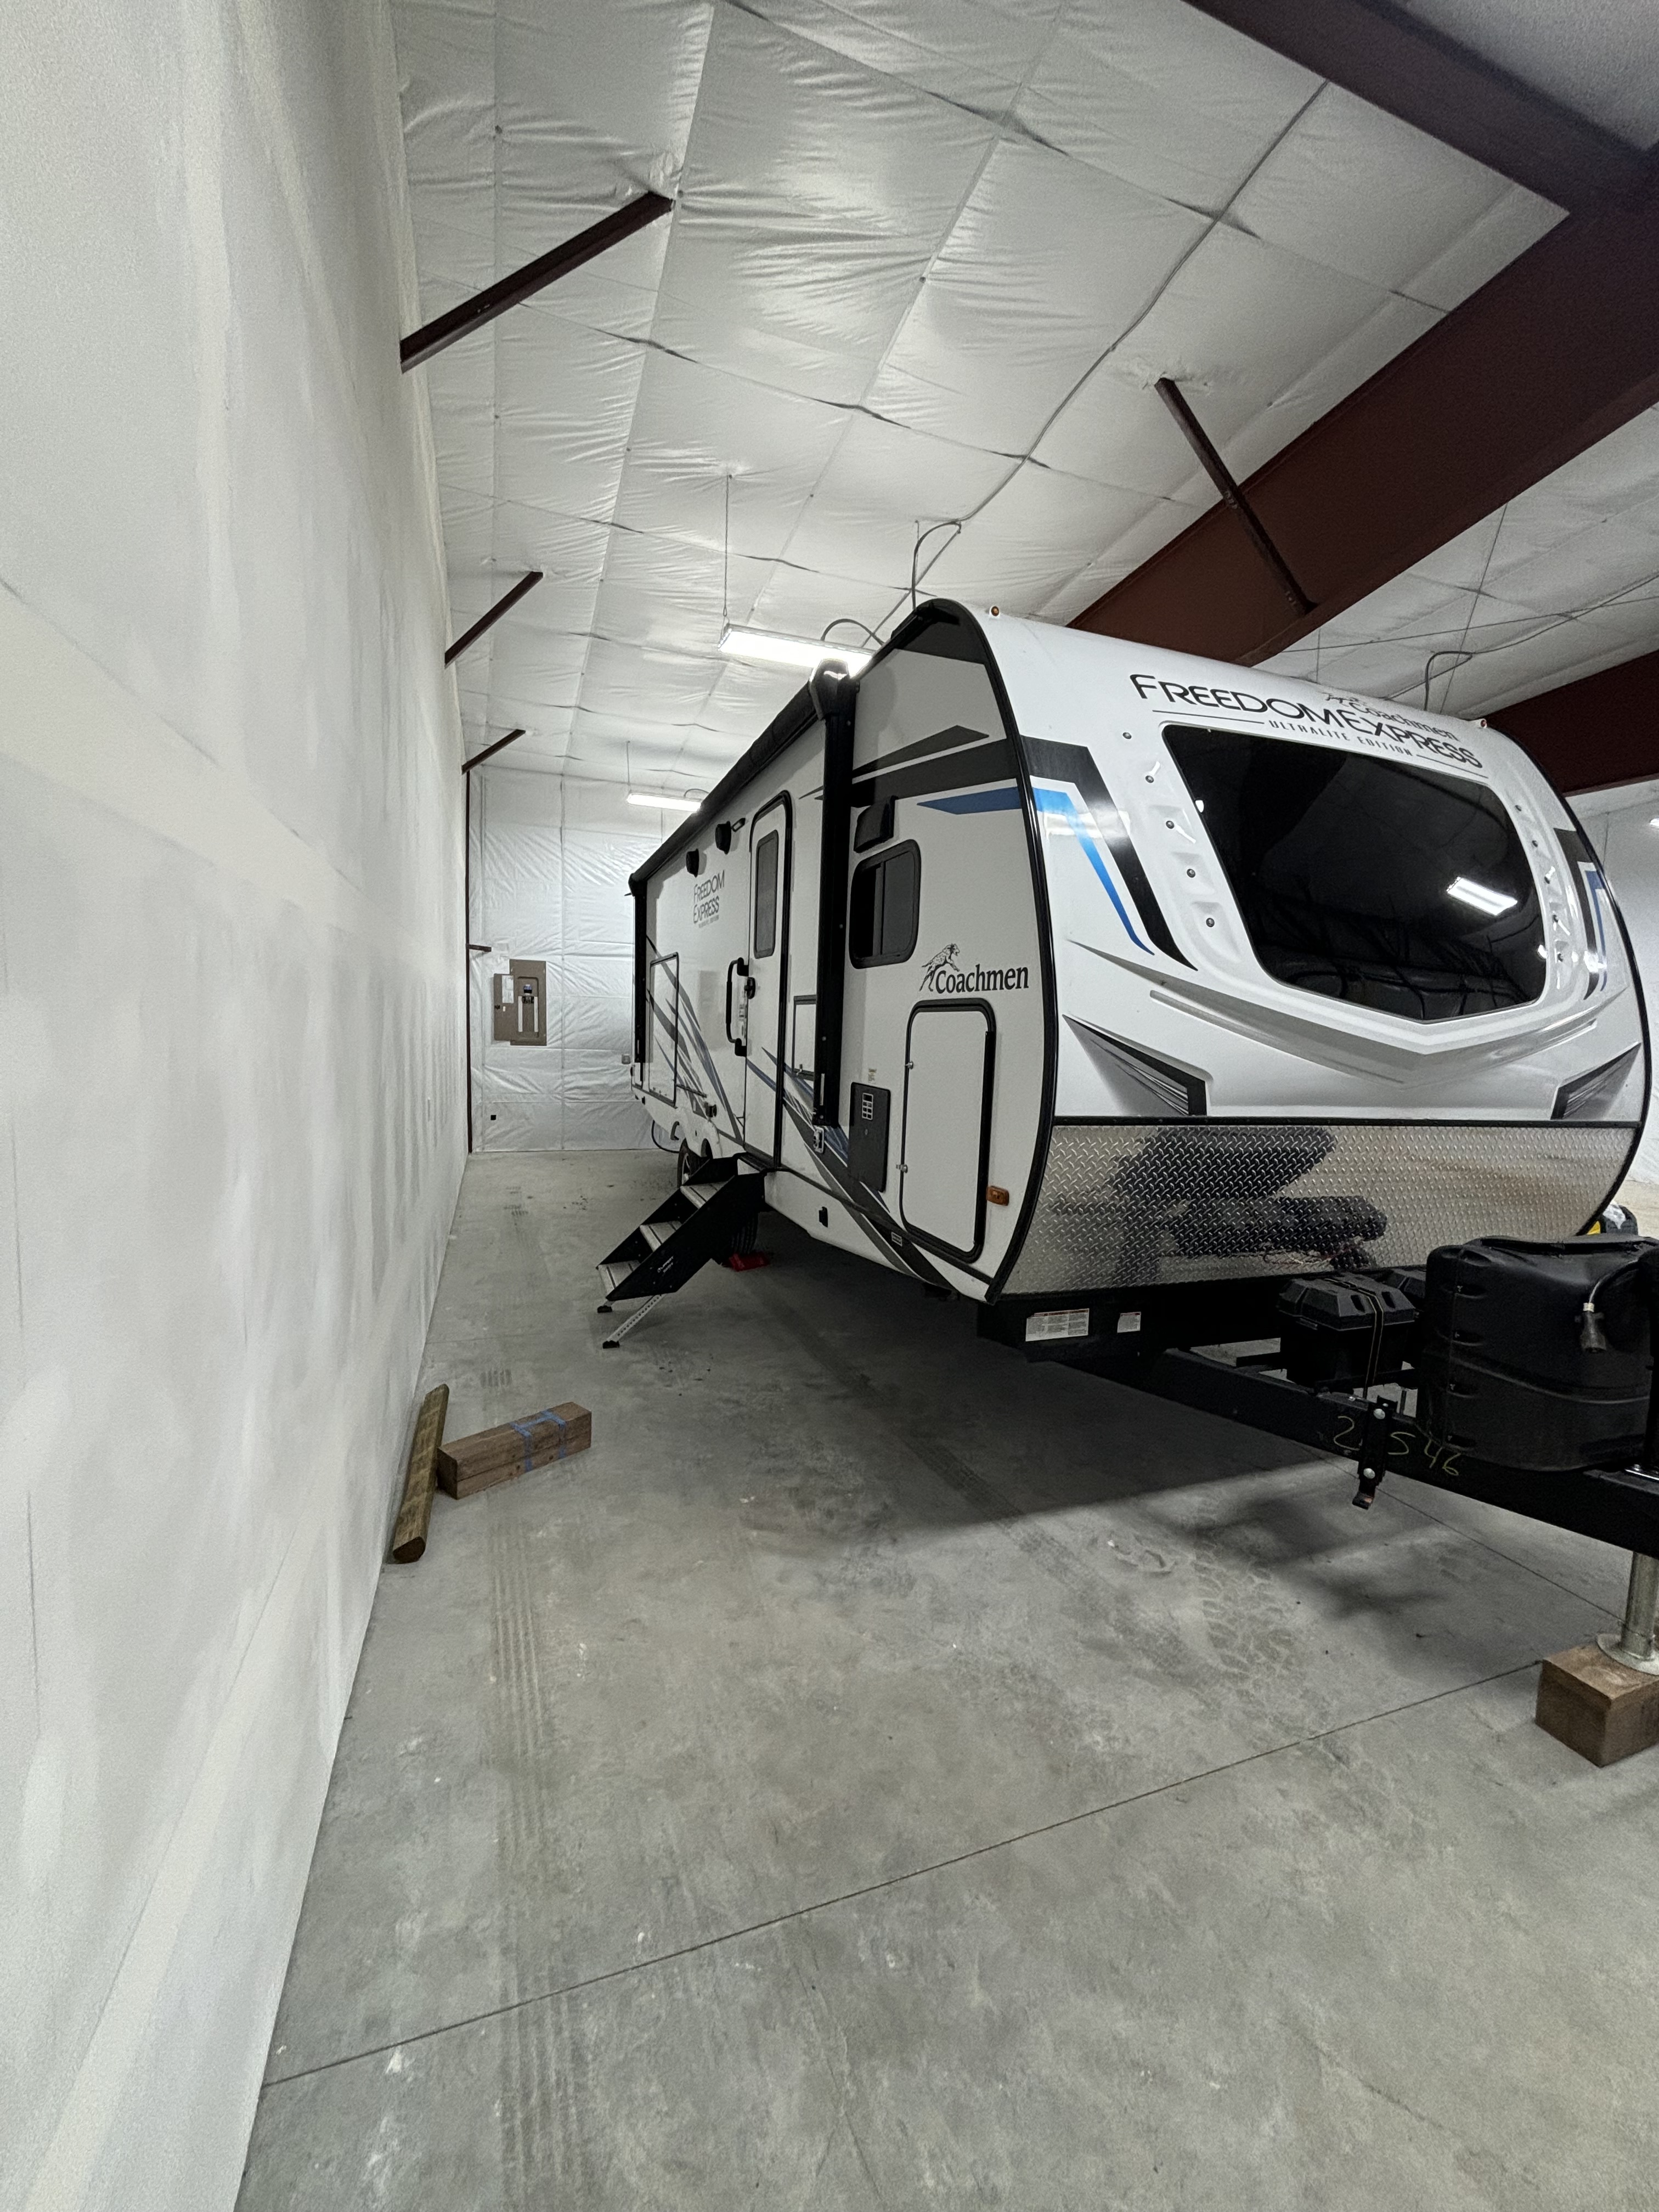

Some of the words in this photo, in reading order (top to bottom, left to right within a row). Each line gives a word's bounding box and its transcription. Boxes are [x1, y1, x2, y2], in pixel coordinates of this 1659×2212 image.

[1268, 720, 1351, 741] ULTRALITE
[1357, 736, 1413, 757] EDITION
[1348, 702, 1460, 742] Coachmen
[693, 870, 724, 904] FREEDOM
[693, 895, 719, 924] EXPRESS
[935, 963, 1029, 994] Coachmen
